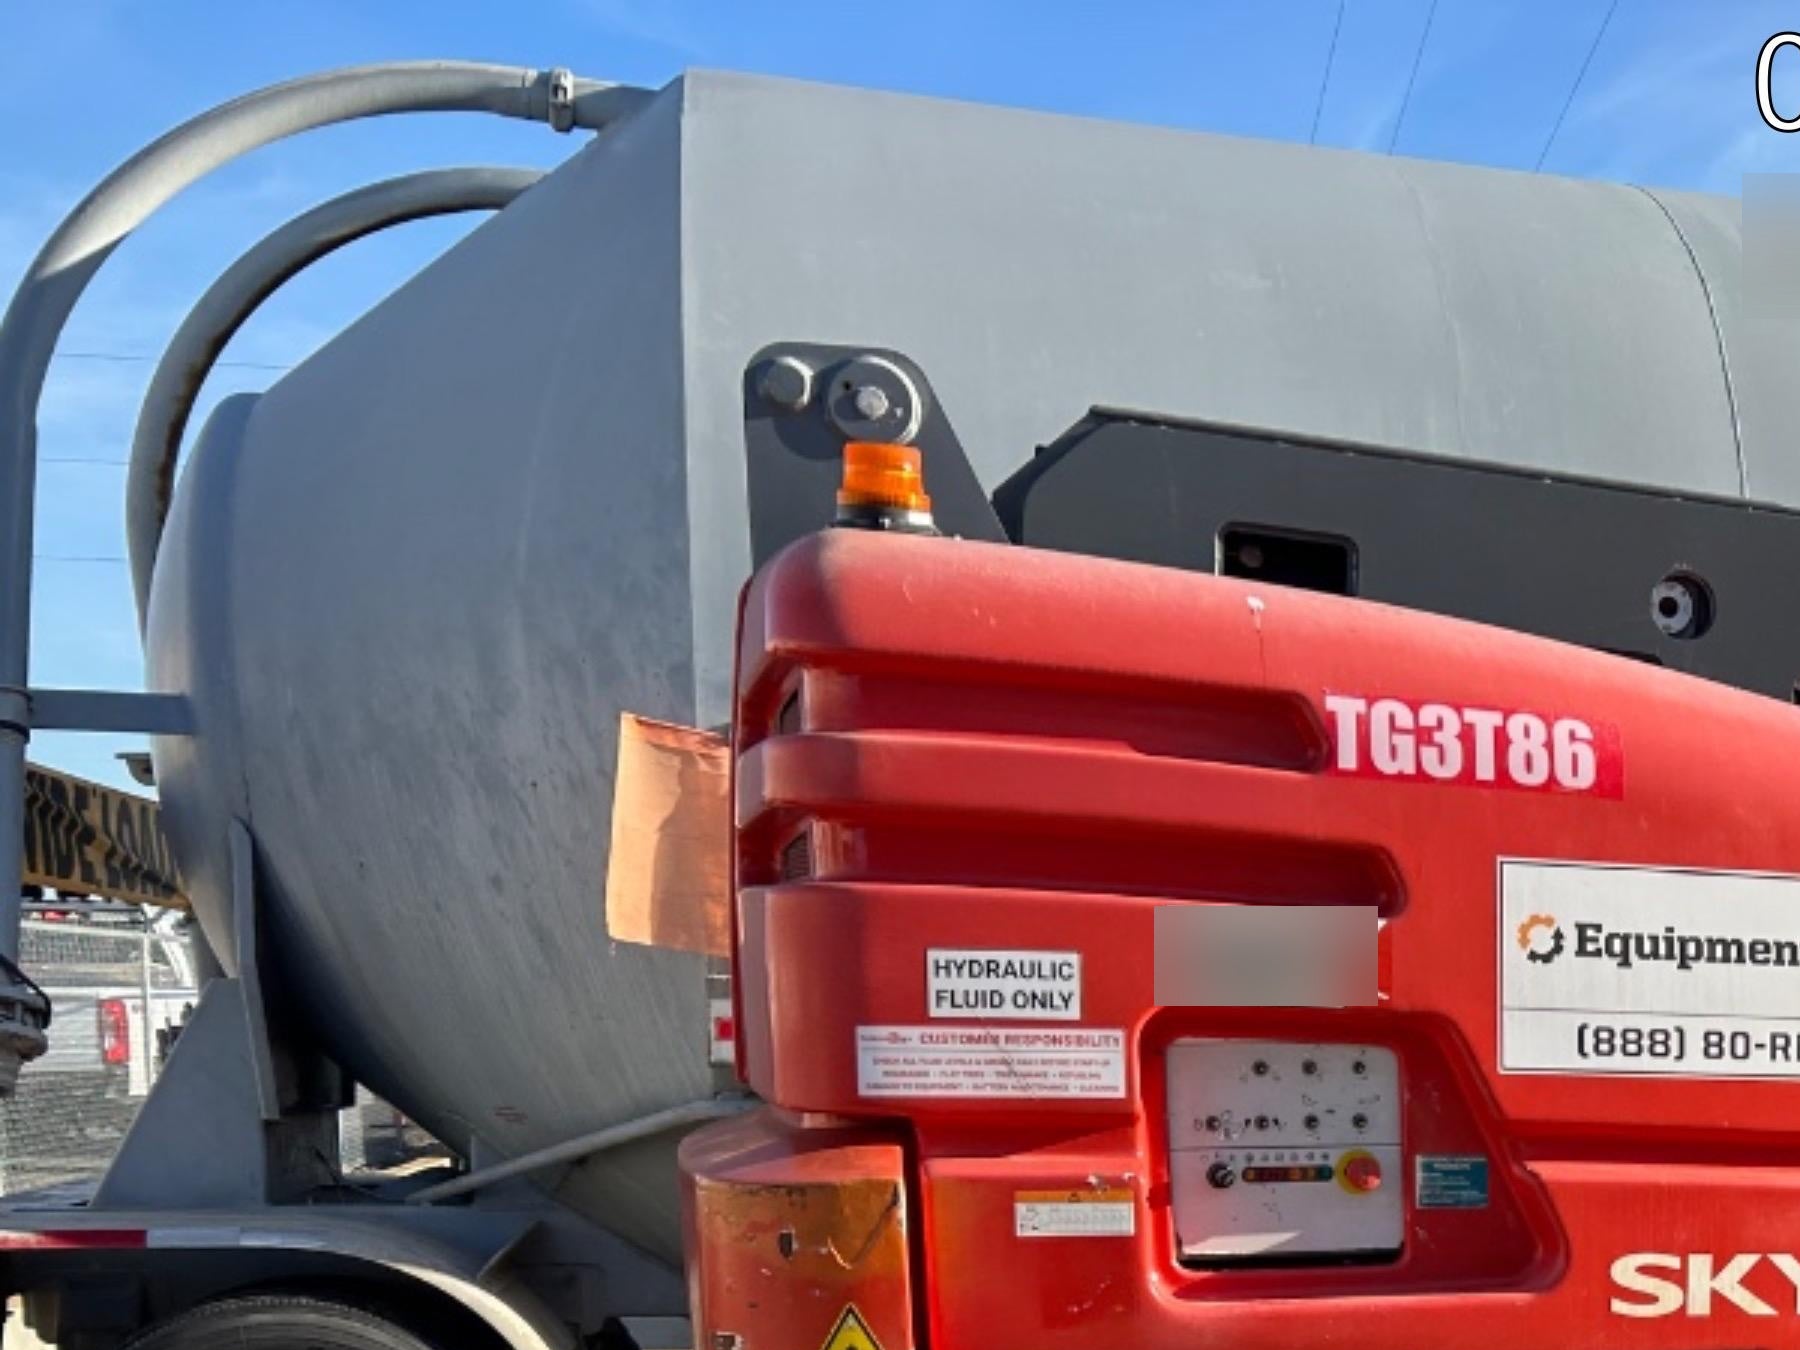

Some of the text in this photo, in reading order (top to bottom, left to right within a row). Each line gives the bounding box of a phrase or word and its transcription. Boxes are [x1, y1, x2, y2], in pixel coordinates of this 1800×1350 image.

[1325, 694, 1597, 790] TG3T86
[932, 958, 1075, 982] HYDRAULIC
[934, 988, 1074, 1012] FLUID ONLY
[1577, 1022, 1686, 1061] (888)
